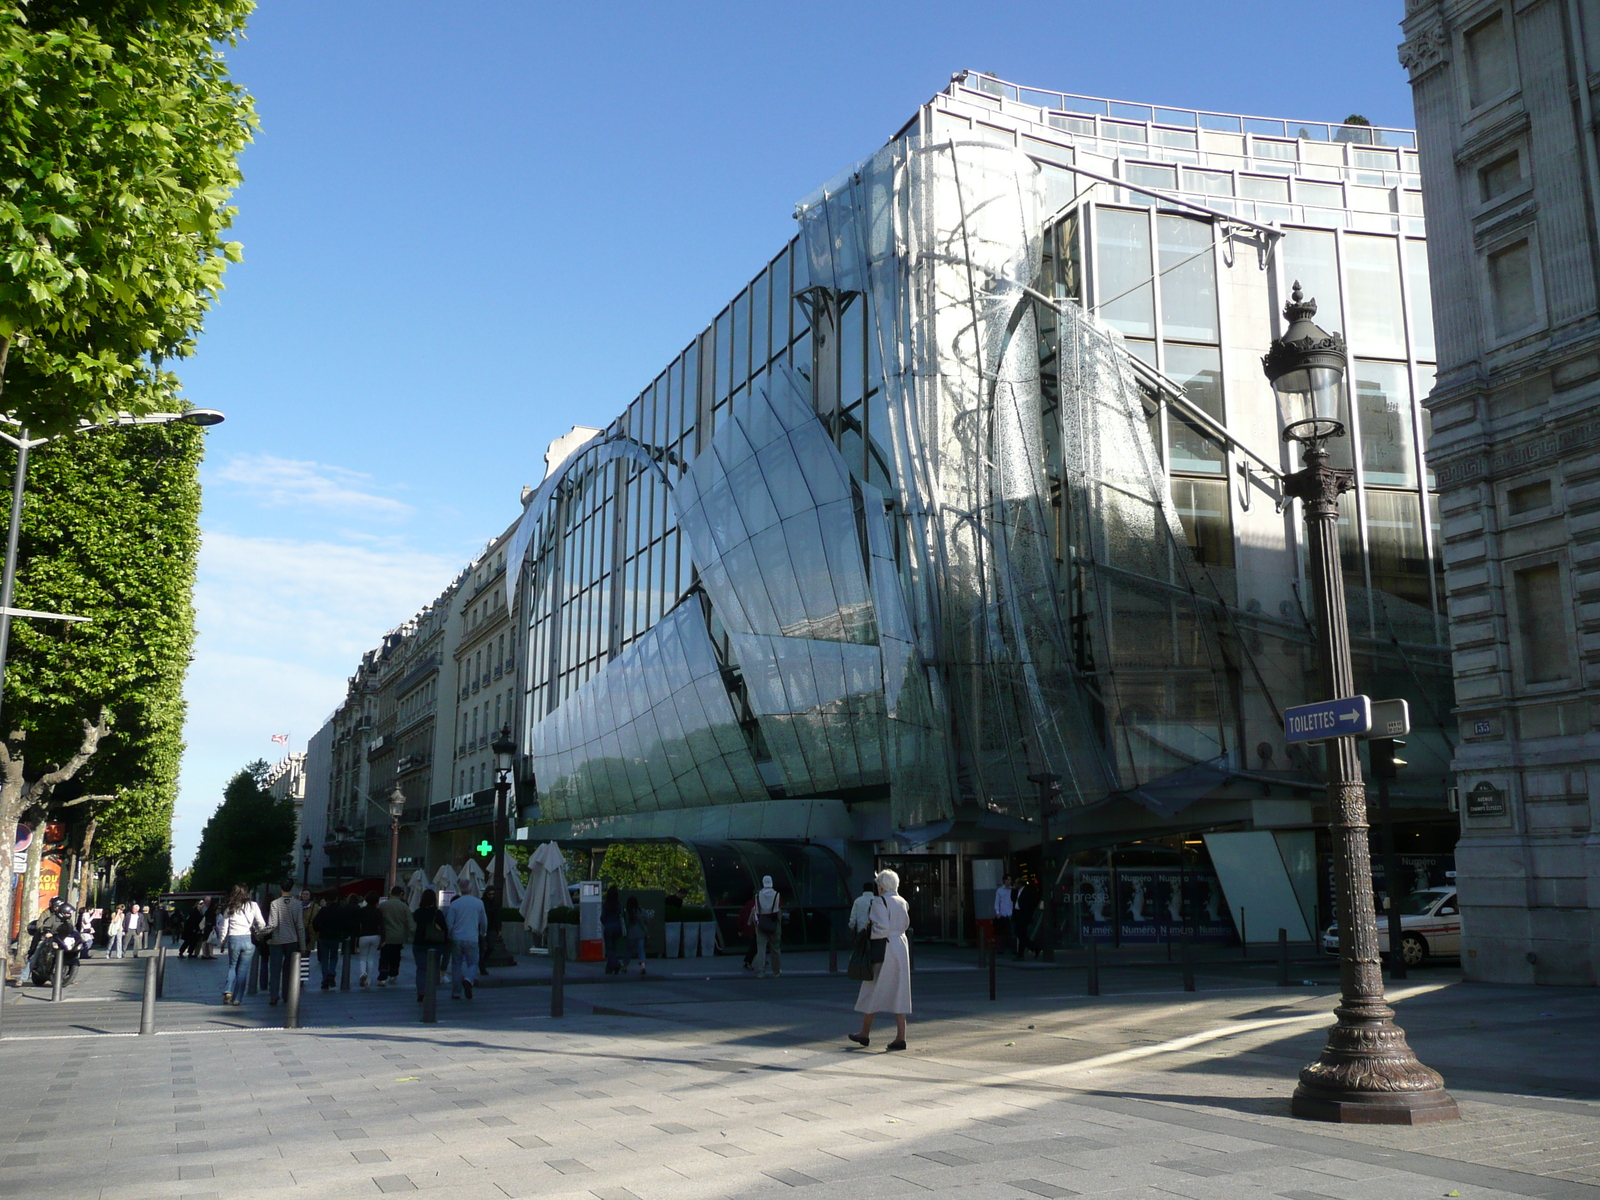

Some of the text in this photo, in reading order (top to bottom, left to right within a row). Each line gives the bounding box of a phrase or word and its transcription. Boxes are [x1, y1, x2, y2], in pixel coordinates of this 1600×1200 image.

[1289, 711, 1335, 733] TOILETTES
[450, 793, 476, 812] LANCEL
[1402, 857, 1436, 867] Numéro
[1121, 873, 1152, 883] Numéro
[1073, 893, 1110, 905] presse
[1122, 924, 1156, 935] Numéro
